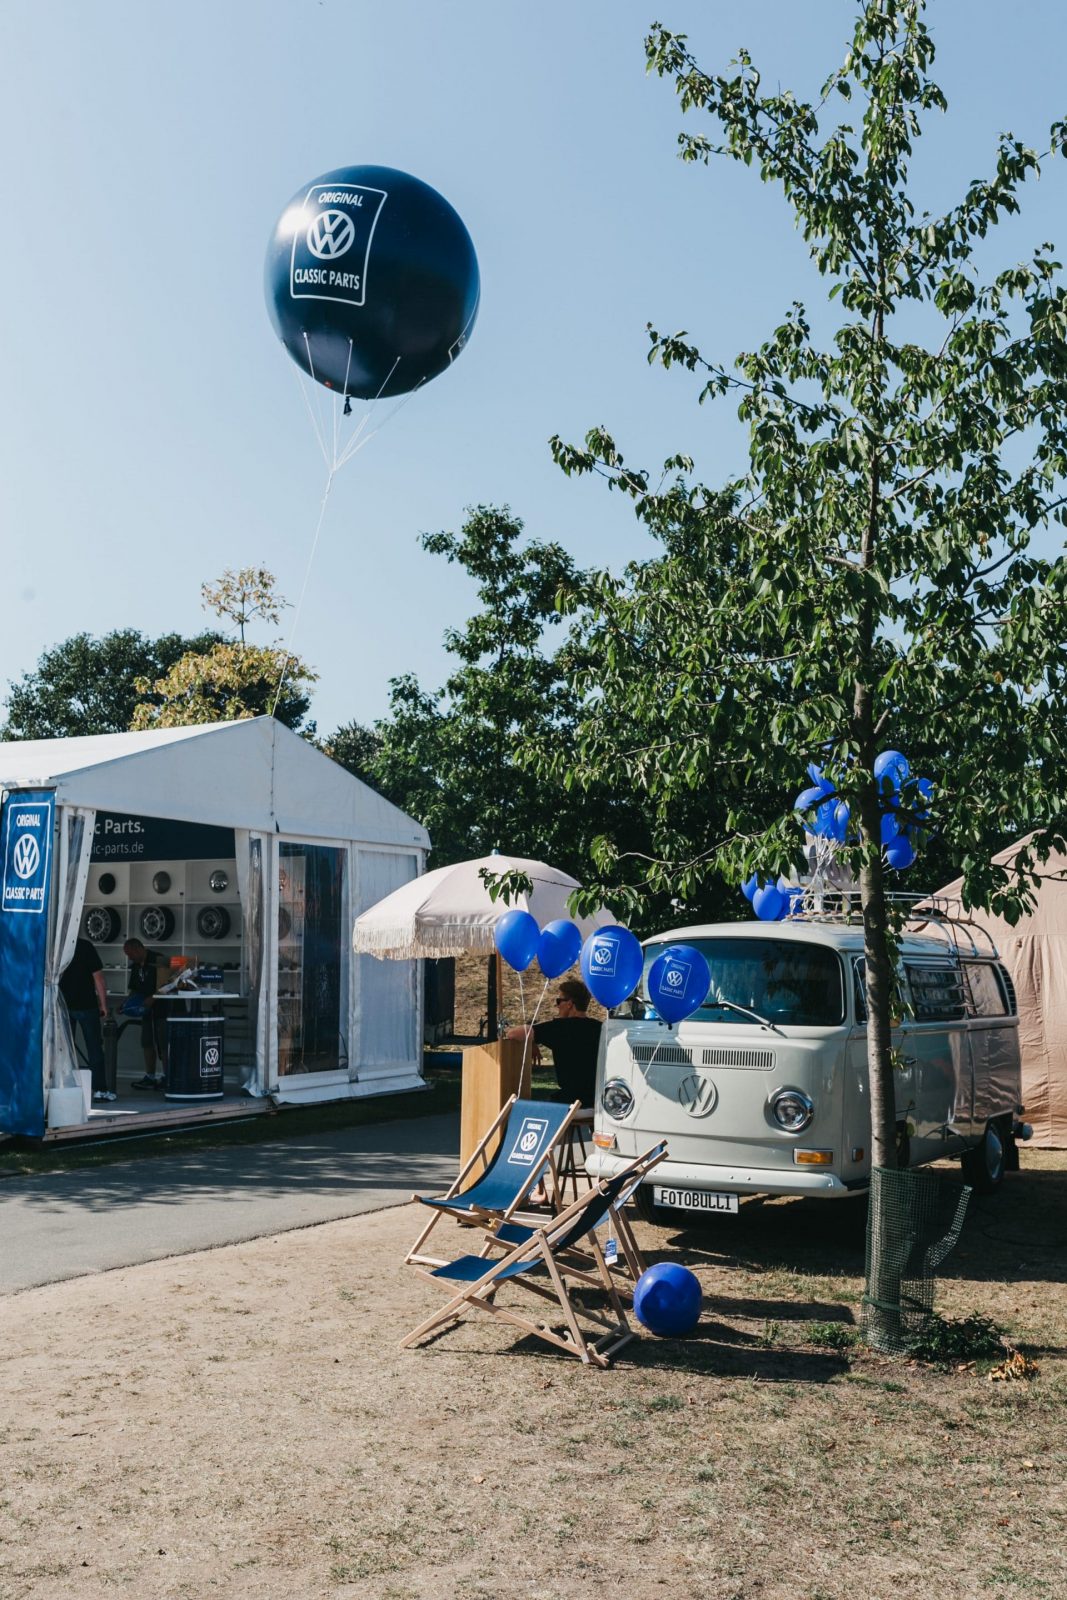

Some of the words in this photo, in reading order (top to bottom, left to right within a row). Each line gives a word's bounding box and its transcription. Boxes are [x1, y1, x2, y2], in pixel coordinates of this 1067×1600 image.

[317, 192, 364, 207] ORIGINAL
[294, 268, 327, 285] CLASSIC
[329, 270, 360, 290] PARTS
[16, 814, 41, 827] ORIGINAL
[104, 819, 145, 834] Parts.
[5, 886, 26, 900] CLASSIC
[26, 886, 44, 901] PARTS
[660, 1189, 732, 1211] FOTOBULLI
